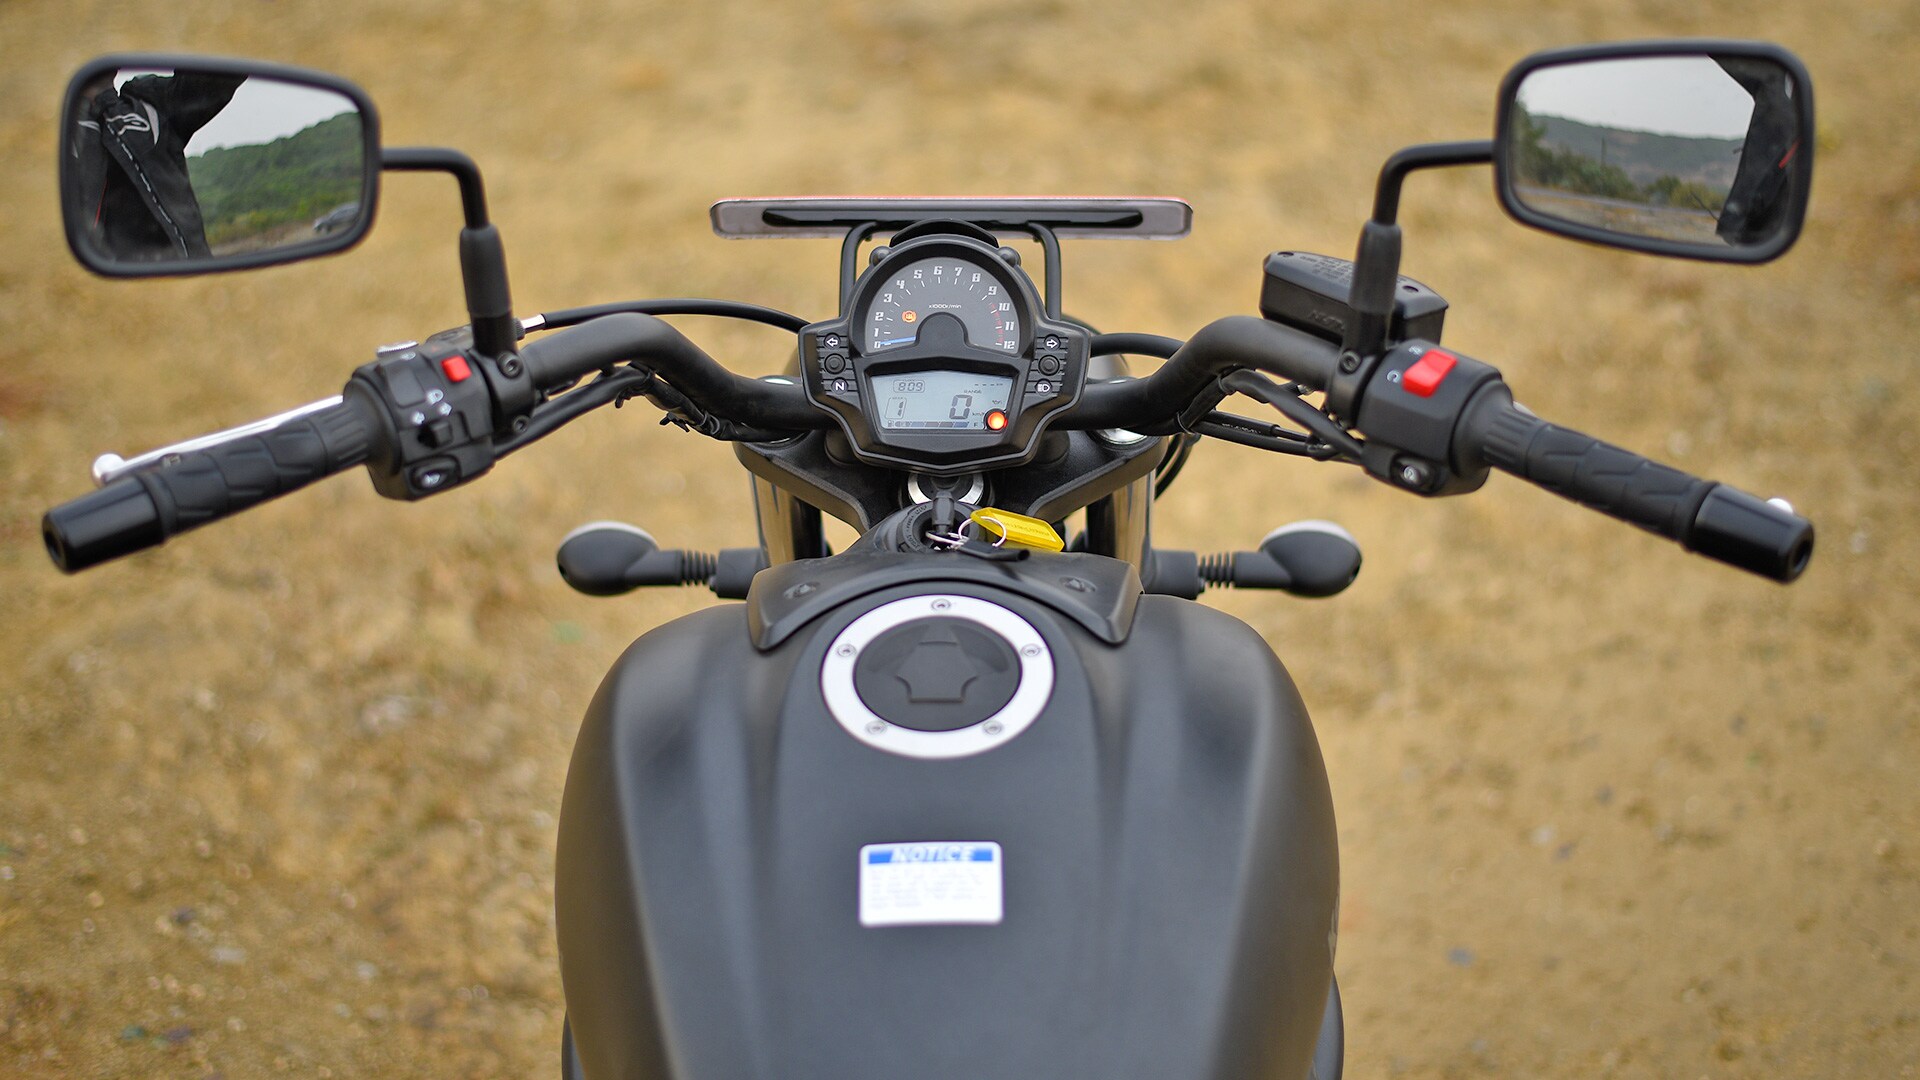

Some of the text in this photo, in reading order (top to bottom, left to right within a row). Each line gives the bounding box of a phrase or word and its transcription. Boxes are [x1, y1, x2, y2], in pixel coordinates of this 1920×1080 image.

[913, 269, 923, 279] 5
[933, 265, 943, 275] 6
[954, 267, 963, 277] 7
[971, 272, 981, 283] 8
[896, 280, 905, 290] 4
[988, 286, 997, 296] 9
[883, 293, 893, 303] 3
[998, 302, 1011, 312] 10
[874, 311, 885, 321] 2
[1004, 321, 1015, 331] 11
[873, 327, 880, 338] 1
[873, 341, 881, 349] 0
[1002, 340, 1016, 350] 12
[835, 382, 845, 391] N
[949, 394, 973, 420] 0
[890, 845, 976, 863] NOTICE
